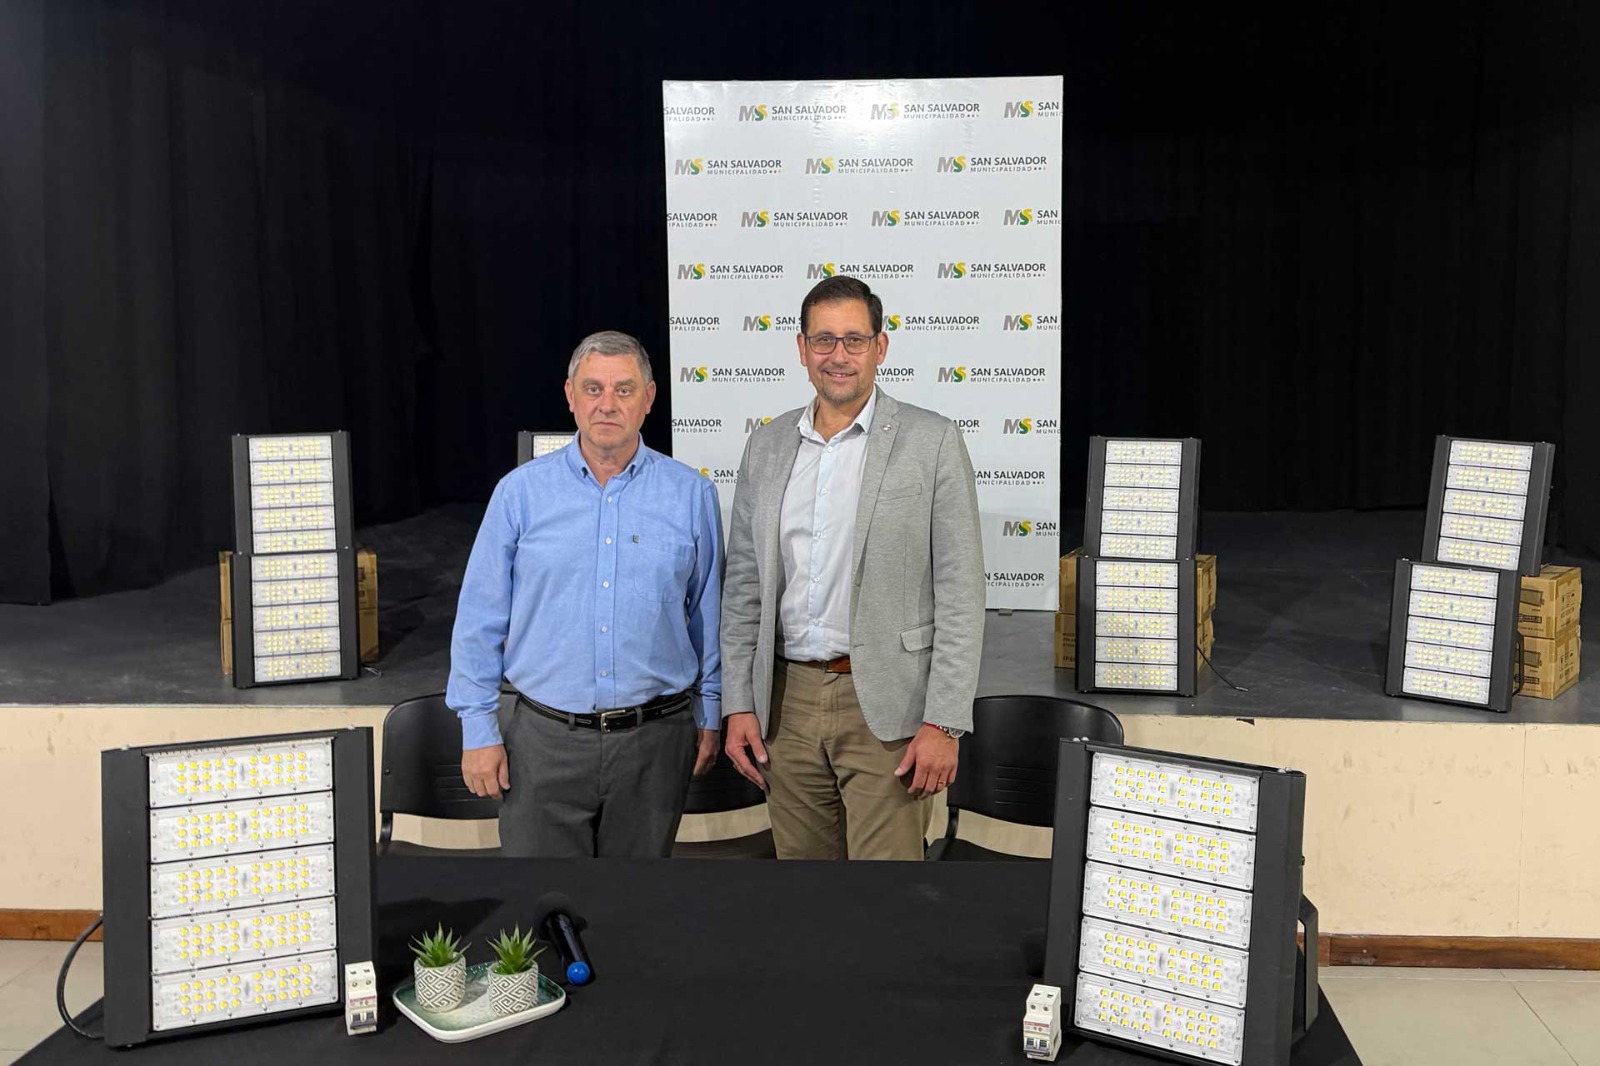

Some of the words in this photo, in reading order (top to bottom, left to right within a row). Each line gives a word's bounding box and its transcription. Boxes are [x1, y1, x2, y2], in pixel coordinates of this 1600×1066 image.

[772, 106, 792, 114] SAN
[795, 106, 846, 114] SALVADOR
[904, 104, 924, 112] SAN
[928, 104, 980, 112] SALVADOR
[1038, 102, 1059, 110] SAN
[708, 160, 728, 168] SAN
[731, 160, 782, 168] SALVADOR
[839, 159, 860, 167] SAN
[862, 158, 913, 167] SALVADOR
[994, 157, 1047, 165] SALVADOR
[797, 212, 848, 220] SALVADOR
[928, 211, 979, 219] SALVADOR
[1037, 210, 1058, 218] SAN
[710, 265, 730, 273] SAN
[733, 265, 783, 273] SALVADOR
[863, 264, 913, 272] SALVADOR
[971, 264, 992, 272] SAN
[906, 316, 925, 324] SAN
[928, 316, 979, 324] SALVADOR
[1037, 316, 1057, 324] SAN
[712, 368, 732, 376] SAN
[735, 368, 785, 376] SALVADOR
[971, 368, 991, 376] SAN
[994, 368, 1045, 376] SALVADOR
[994, 471, 1045, 479] SALVADOR
[1036, 522, 1056, 530] SAN
[994, 573, 1044, 581] SALVADOR
